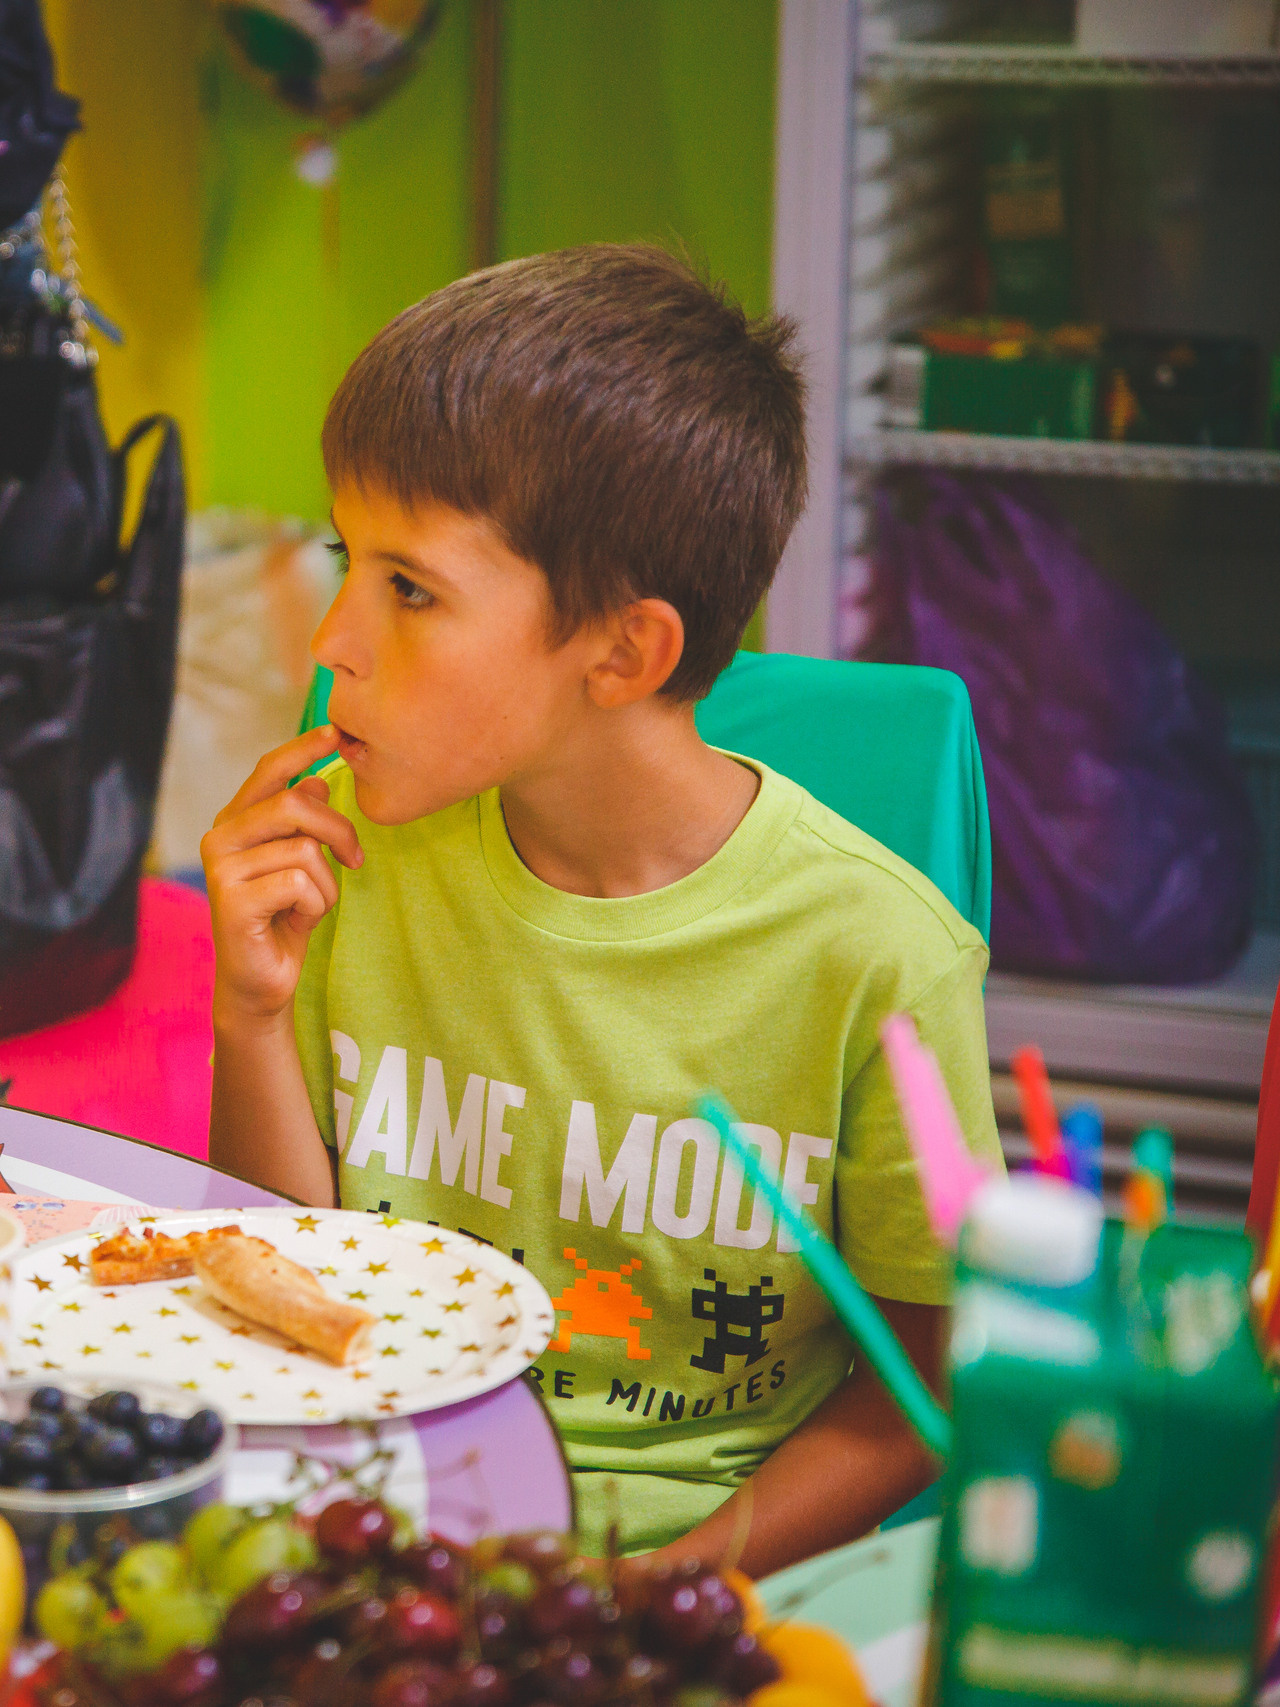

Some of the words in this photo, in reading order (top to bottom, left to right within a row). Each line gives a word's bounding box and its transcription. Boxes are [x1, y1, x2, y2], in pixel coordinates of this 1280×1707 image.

[328, 1028, 527, 1209] GAME
[558, 1099, 834, 1254] MODE
[605, 1359, 786, 1422] MINUTES
